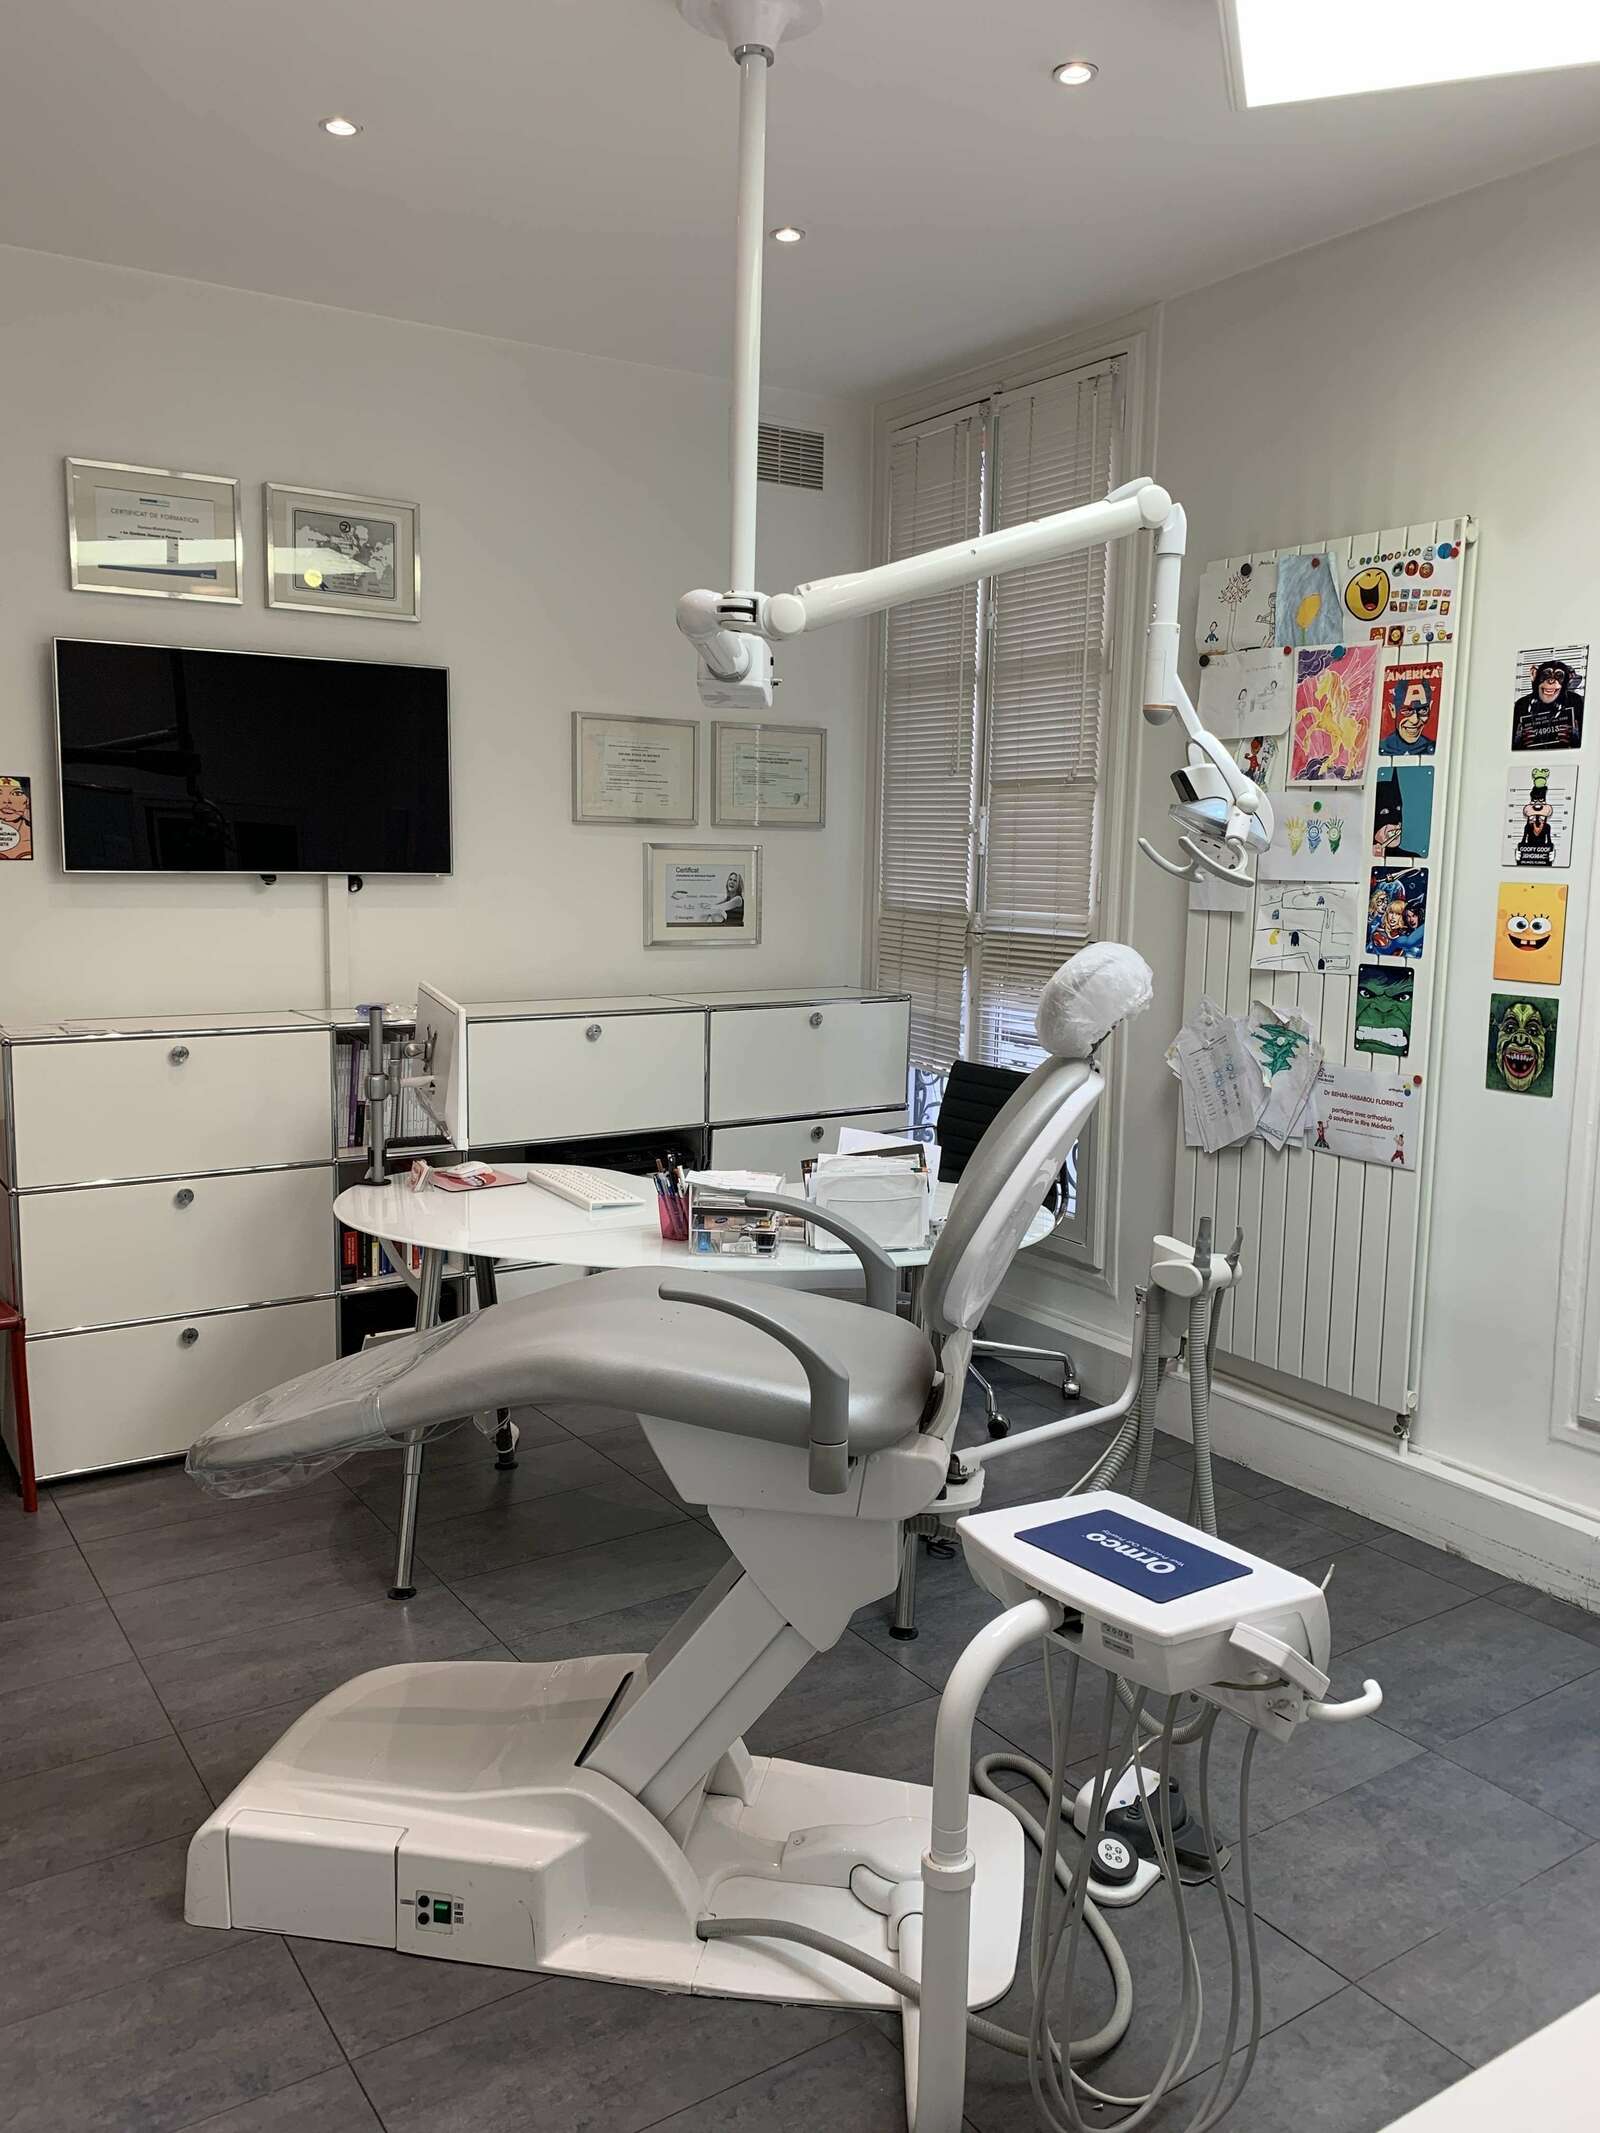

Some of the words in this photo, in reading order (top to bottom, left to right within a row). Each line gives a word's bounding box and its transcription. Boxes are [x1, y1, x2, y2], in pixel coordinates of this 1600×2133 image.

[110, 507, 148, 518] CERTIFICAT
[149, 511, 158, 519] DE
[160, 513, 200, 525] FORMATION
[1386, 669, 1440, 681] AMERICA
[1403, 684, 1428, 706] A
[675, 866, 700, 874] Certificat
[1375, 1098, 1404, 1108] FLORENCE
[1331, 1107, 1354, 1117] participe
[1366, 1112, 1393, 1123] orthoplus
[1333, 1115, 1354, 1124] soutenir
[1085, 1532, 1177, 1574] Ormco
